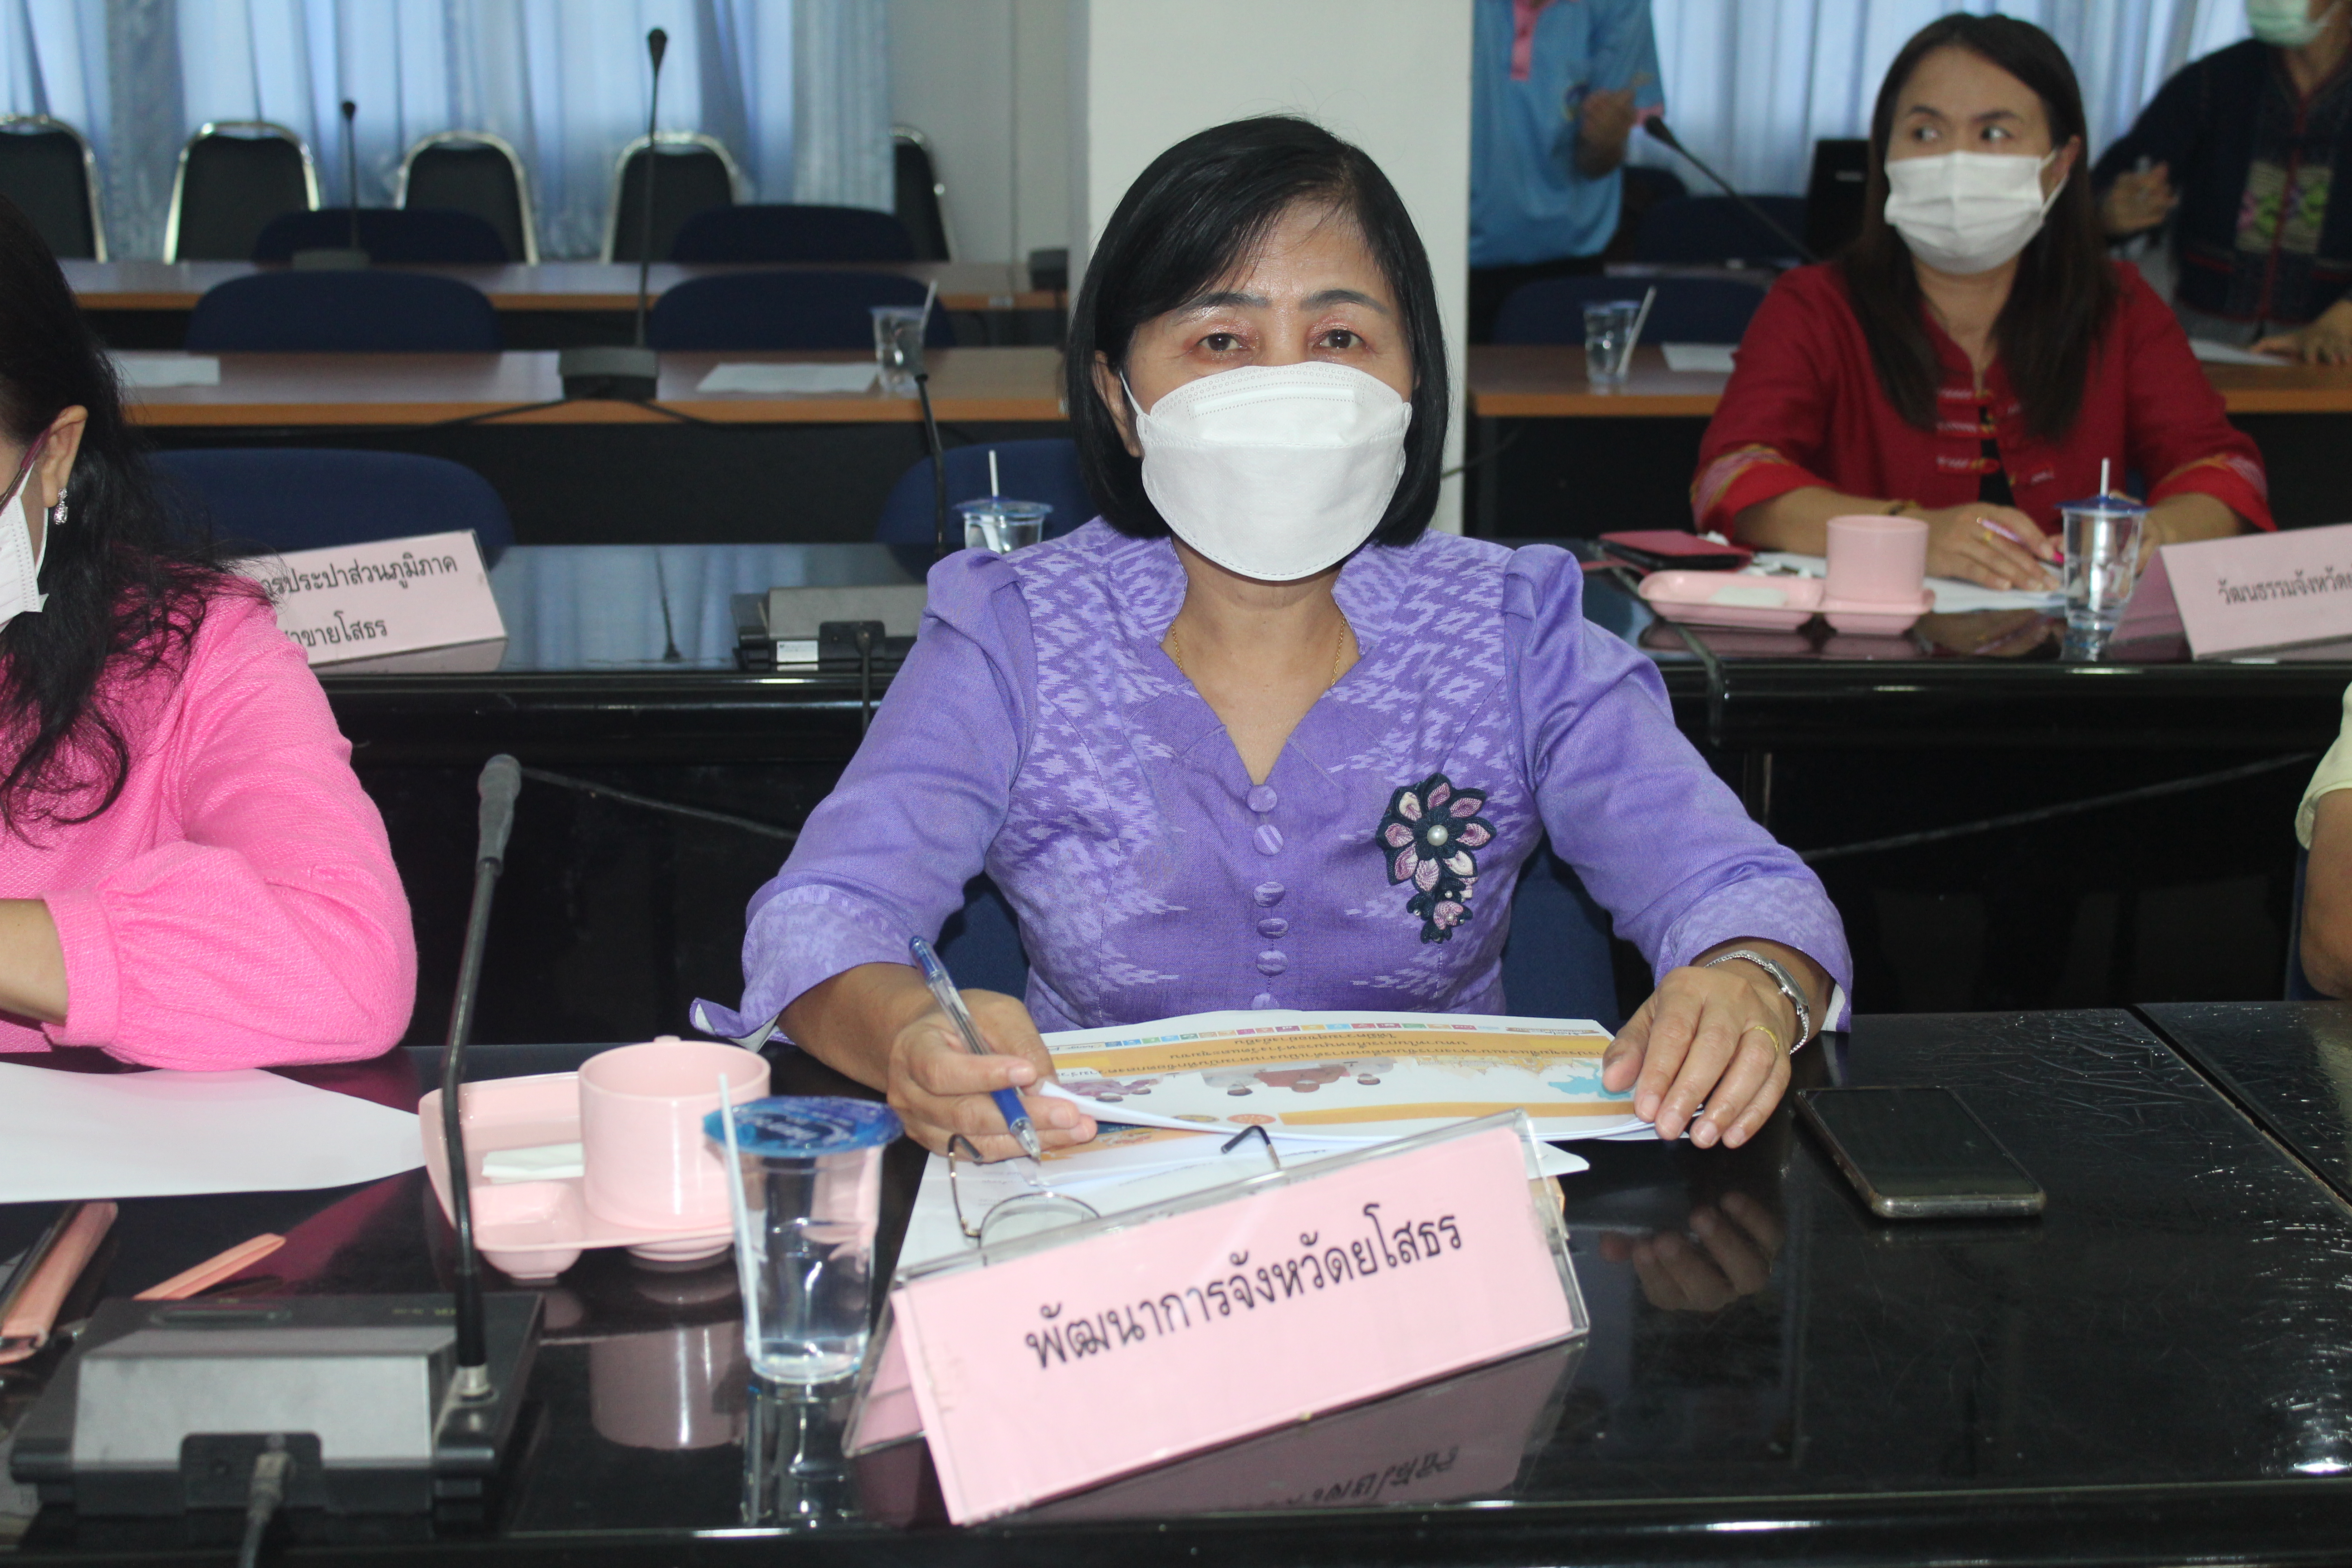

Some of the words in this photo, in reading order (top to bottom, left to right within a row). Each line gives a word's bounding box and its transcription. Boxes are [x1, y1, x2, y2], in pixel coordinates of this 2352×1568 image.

[259, 552, 459, 594] ารประปาส่วนภูมิภาค
[285, 610, 388, 647] าขายโสธร
[1025, 1203, 1462, 1369] พัฒนาการจังหวัดยโสธร
